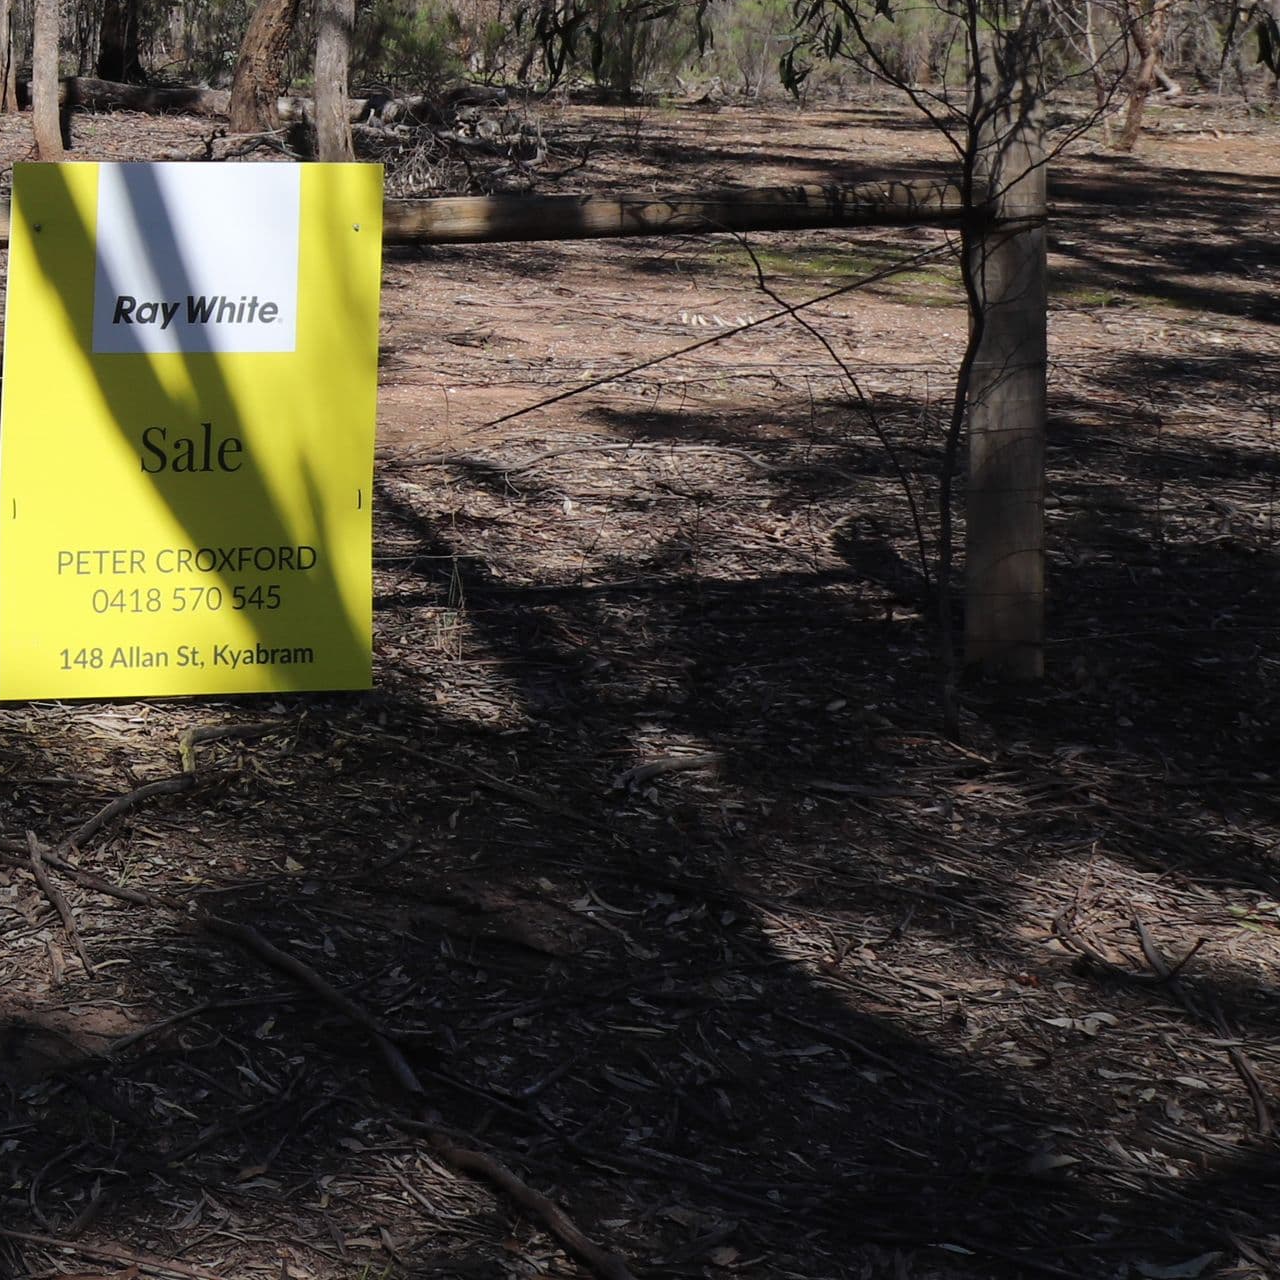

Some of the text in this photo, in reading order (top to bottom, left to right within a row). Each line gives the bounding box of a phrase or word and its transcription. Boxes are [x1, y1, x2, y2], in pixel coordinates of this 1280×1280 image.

[112, 295, 279, 330] Ray White
[140, 422, 243, 474] Sale
[57, 545, 317, 575] PETER CROXFORD
[91, 584, 281, 613] 0418 570 545
[59, 642, 314, 670] 148 Allan St, Kyabram
